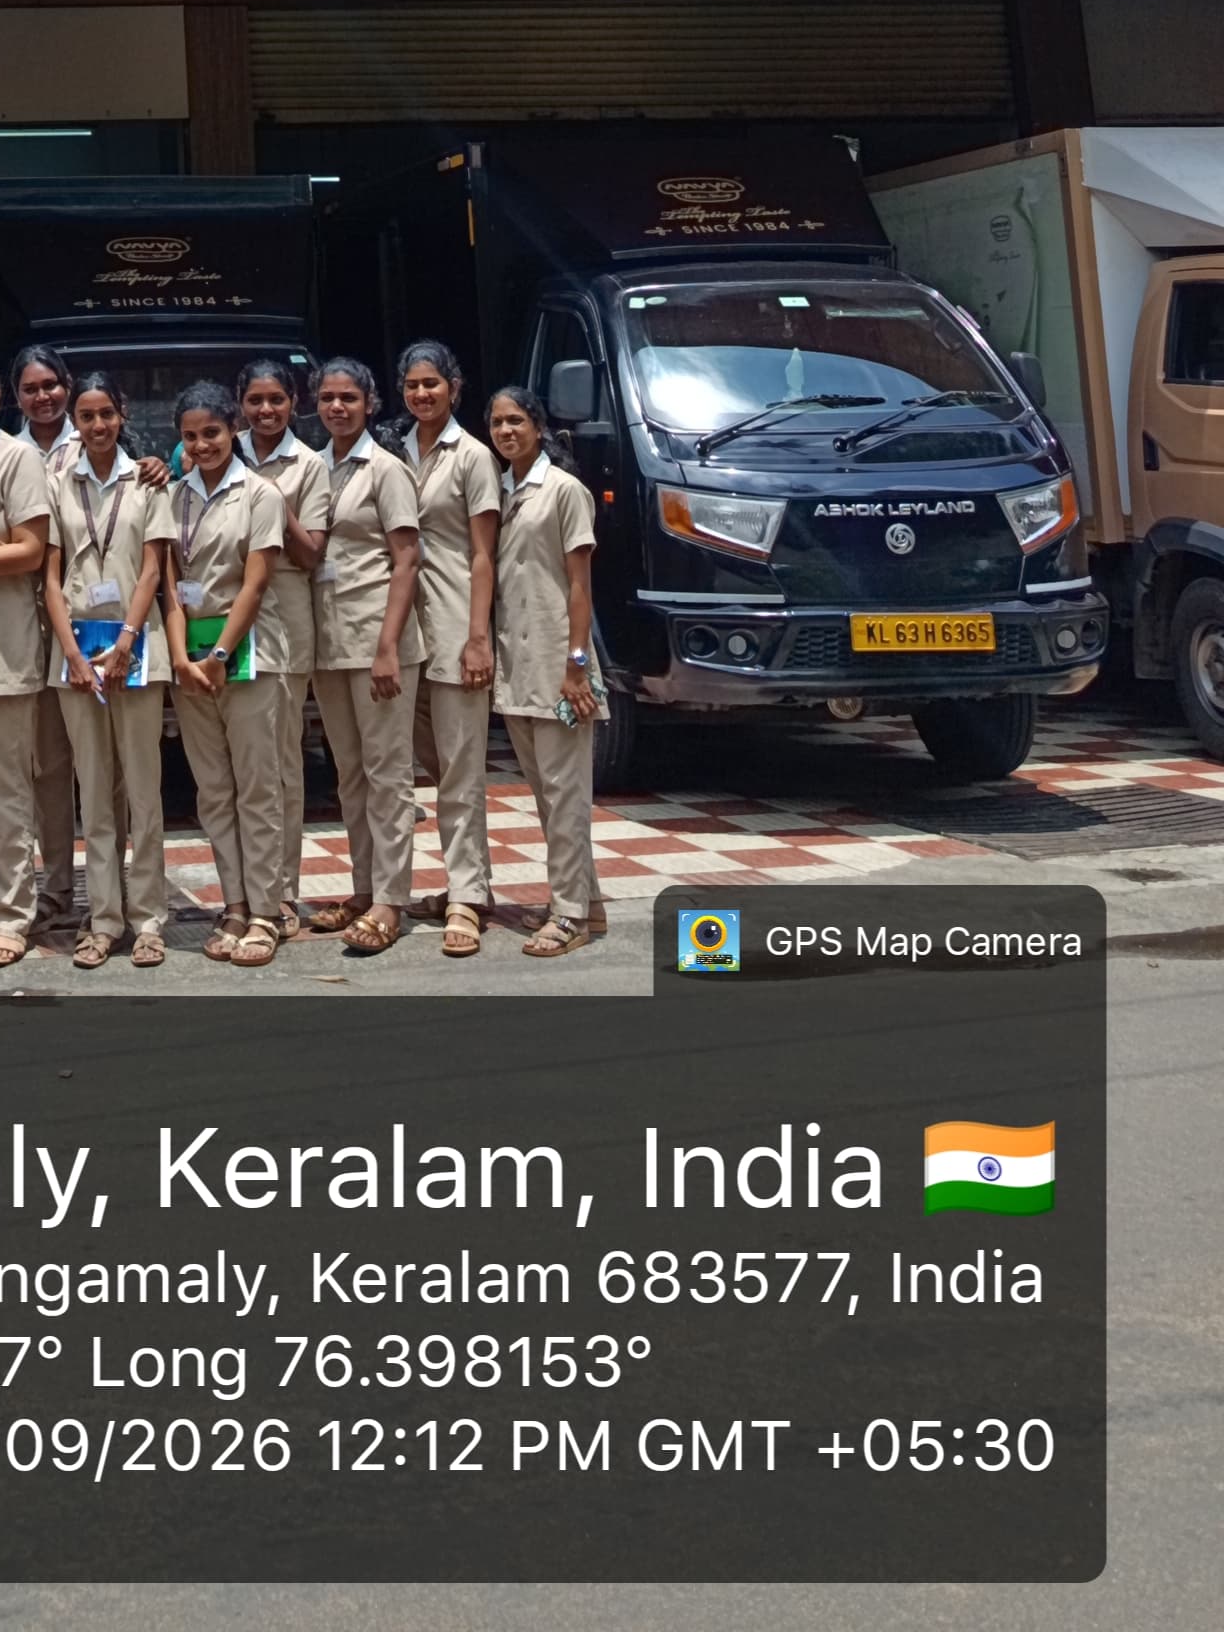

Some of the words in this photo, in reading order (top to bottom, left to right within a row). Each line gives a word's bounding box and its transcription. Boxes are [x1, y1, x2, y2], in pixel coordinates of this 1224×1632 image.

[681, 224, 739, 234] SINCE
[744, 221, 790, 231] 1984
[111, 297, 166, 307] SINCE
[173, 296, 217, 306] 1984
[814, 503, 885, 516] ASHOK
[888, 500, 976, 515] LEYLAND
[866, 622, 890, 644] KL
[895, 622, 919, 643] 63
[925, 622, 936, 643] H
[941, 621, 990, 643] 6365
